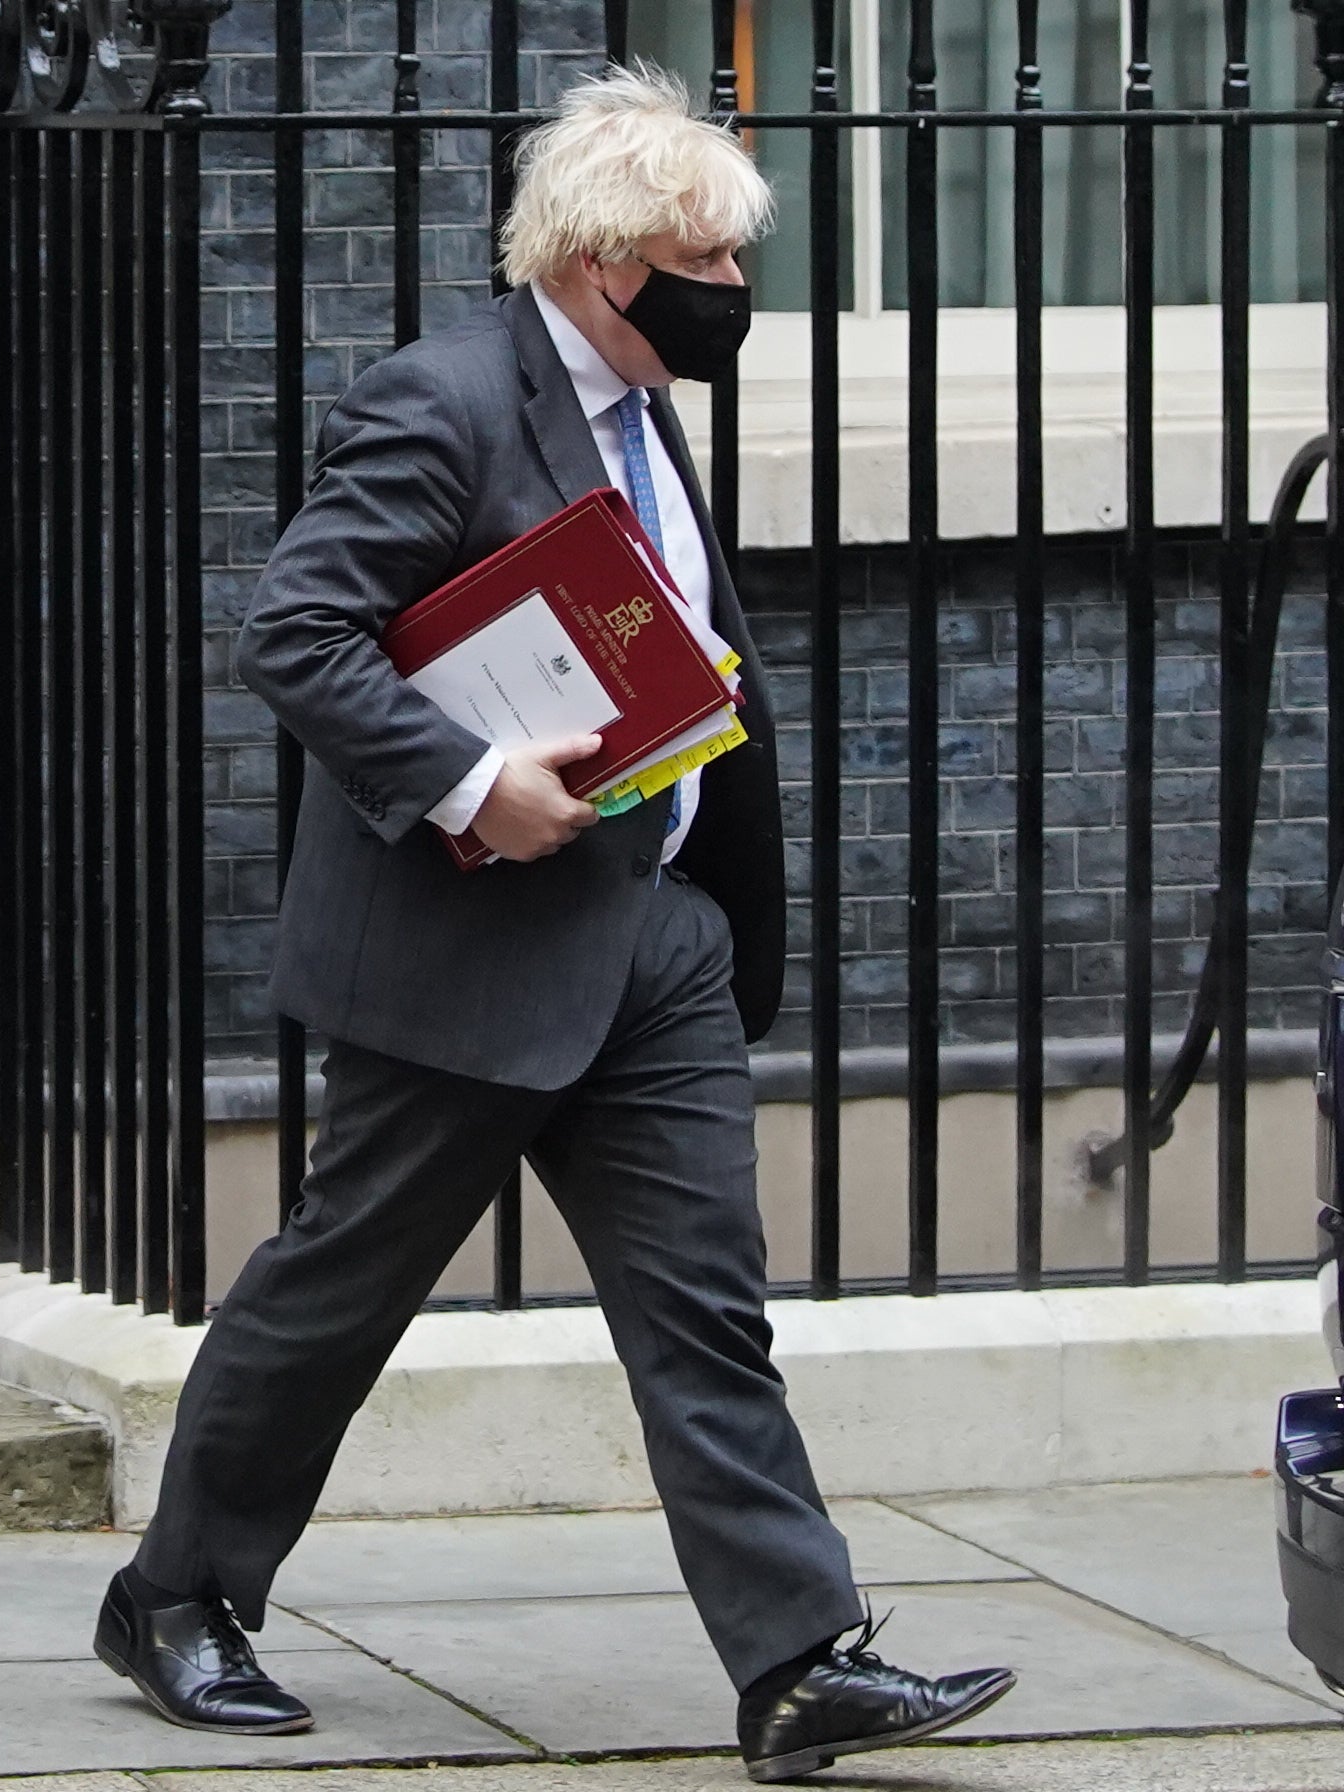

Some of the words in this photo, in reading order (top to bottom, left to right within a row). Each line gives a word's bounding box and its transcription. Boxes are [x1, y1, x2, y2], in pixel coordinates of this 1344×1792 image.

[555, 583, 573, 604] FIRST
[570, 605, 588, 628] LORD
[586, 628, 597, 639] OF
[594, 641, 609, 659] THE
[606, 659, 637, 700] TREASURY
[583, 604, 603, 629] PRIME
[600, 628, 628, 665] MINISTER
